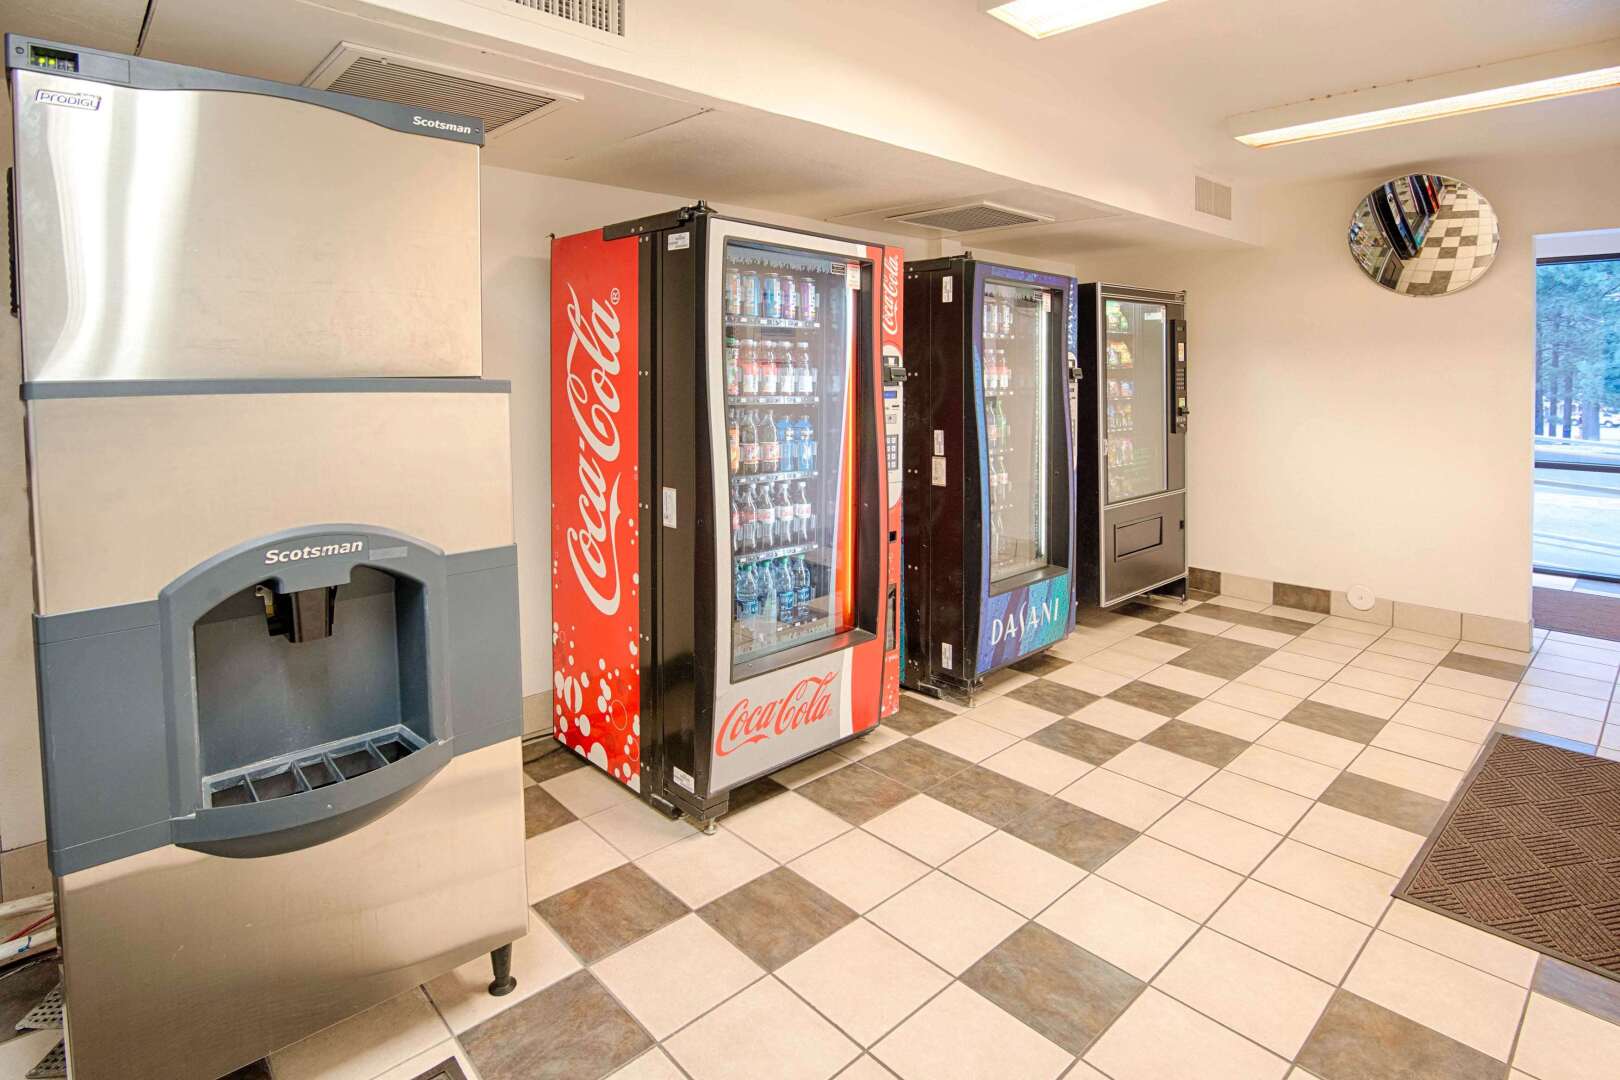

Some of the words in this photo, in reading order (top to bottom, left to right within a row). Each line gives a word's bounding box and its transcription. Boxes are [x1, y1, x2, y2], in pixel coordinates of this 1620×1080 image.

[412, 115, 471, 134] Scotsman
[264, 540, 364, 565] Scotsman
[991, 597, 1060, 646] DASANI
